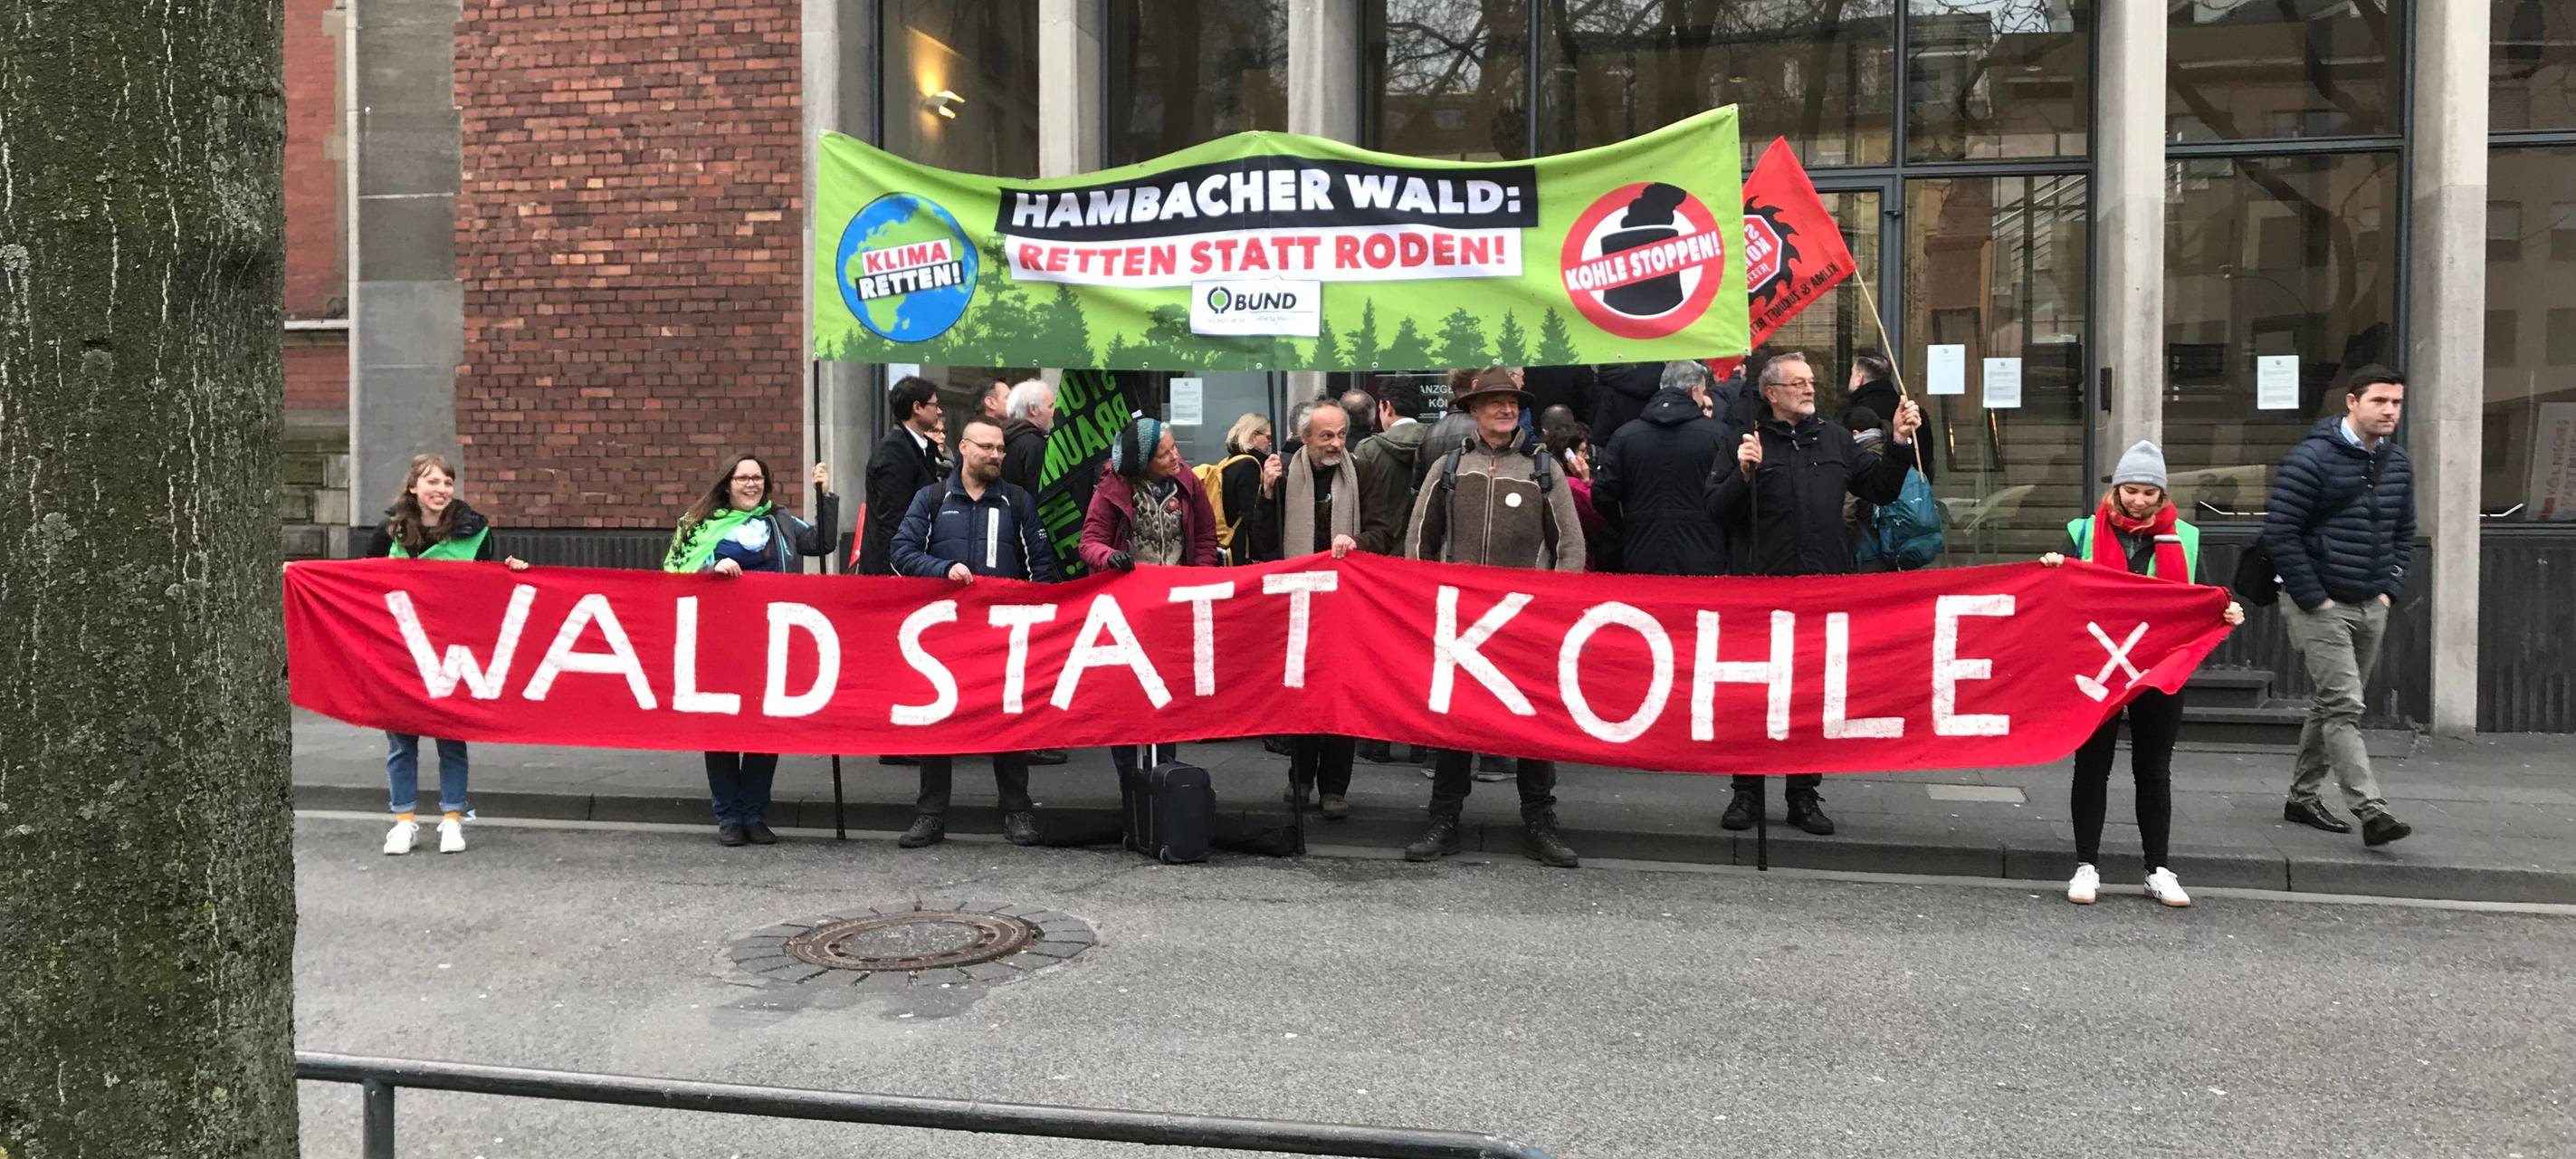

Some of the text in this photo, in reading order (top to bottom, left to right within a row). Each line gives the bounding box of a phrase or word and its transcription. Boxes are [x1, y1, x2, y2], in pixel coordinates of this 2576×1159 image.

[1011, 168, 1522, 228] HAMBACHER WALD:
[865, 242, 949, 273] KLIMA
[1018, 232, 1505, 277] RETTEN STATT RODEN!
[1565, 231, 1721, 291] KOHLE STOPPEN!
[859, 263, 962, 300] RETTEN!
[1234, 292, 1298, 311] BUND
[384, 570, 2017, 743] WALD STATT KOHLE
